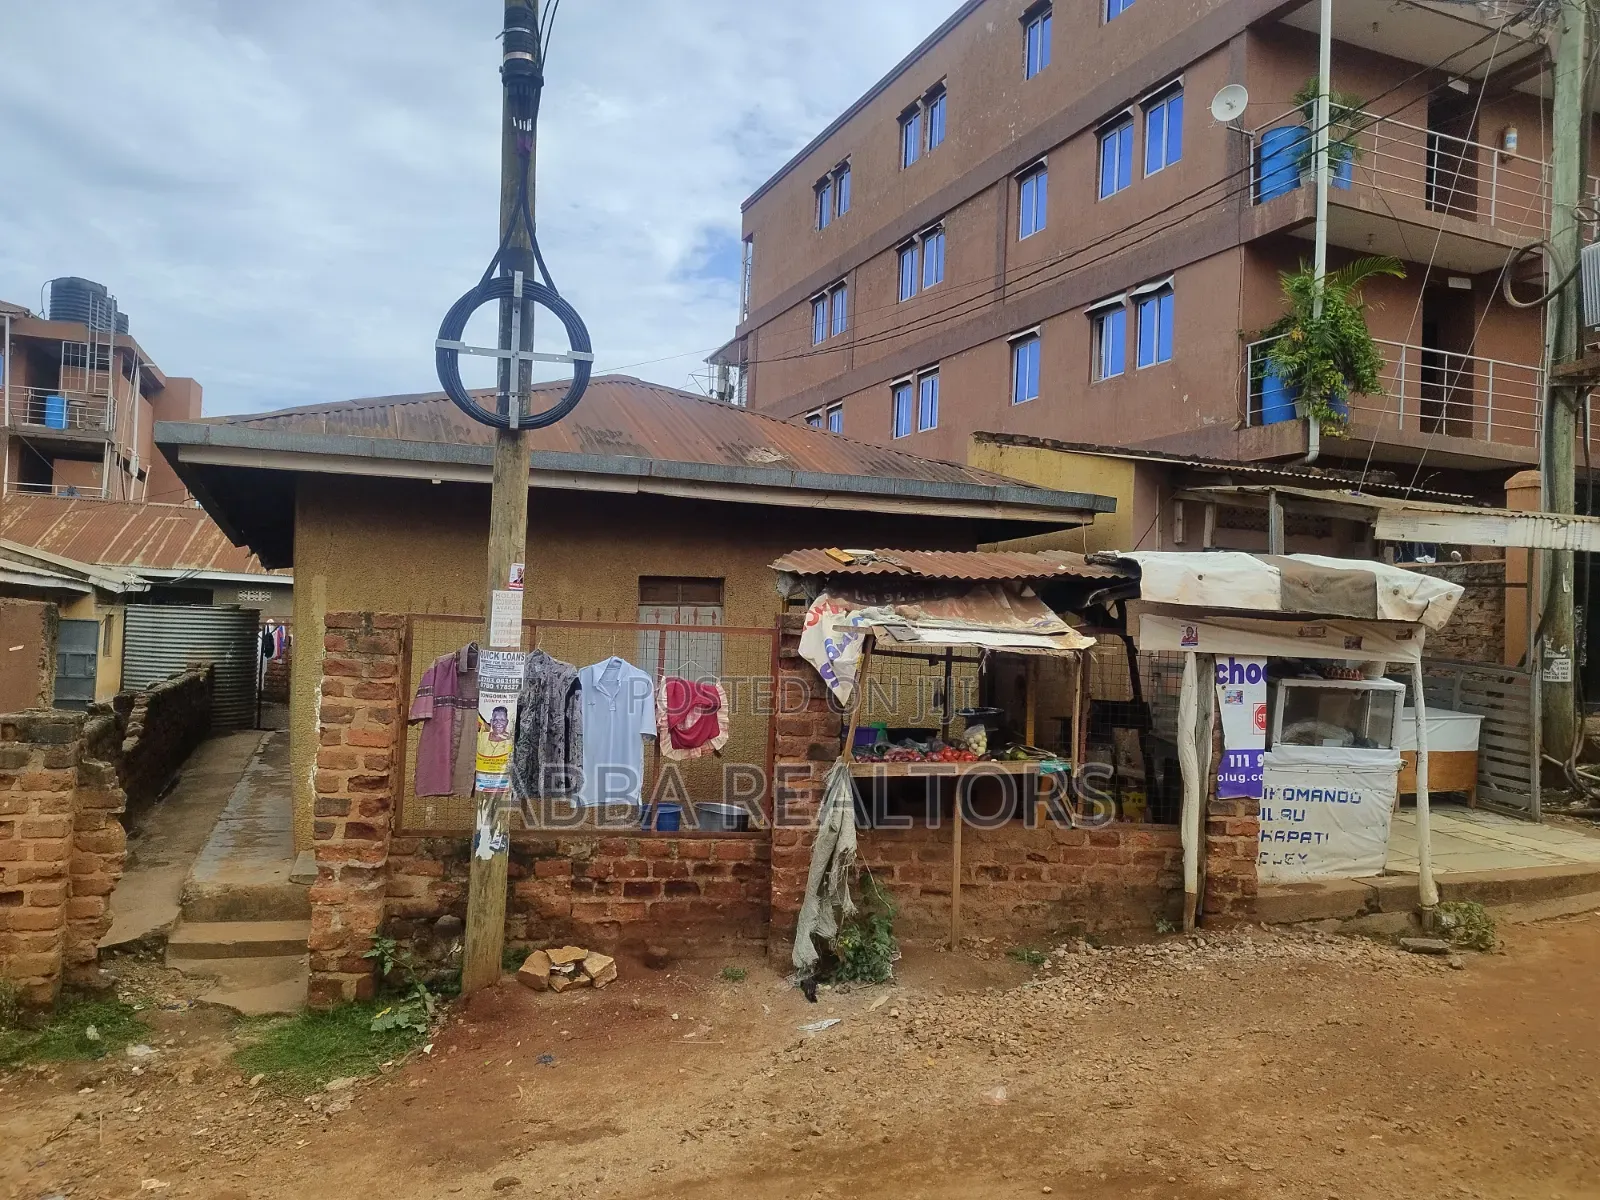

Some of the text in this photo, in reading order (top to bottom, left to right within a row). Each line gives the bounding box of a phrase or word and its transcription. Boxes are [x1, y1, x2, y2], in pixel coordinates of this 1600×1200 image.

[502, 652, 525, 662] LOANS
[1229, 754, 1250, 767] 111
[1256, 808, 1305, 822] ILAU
